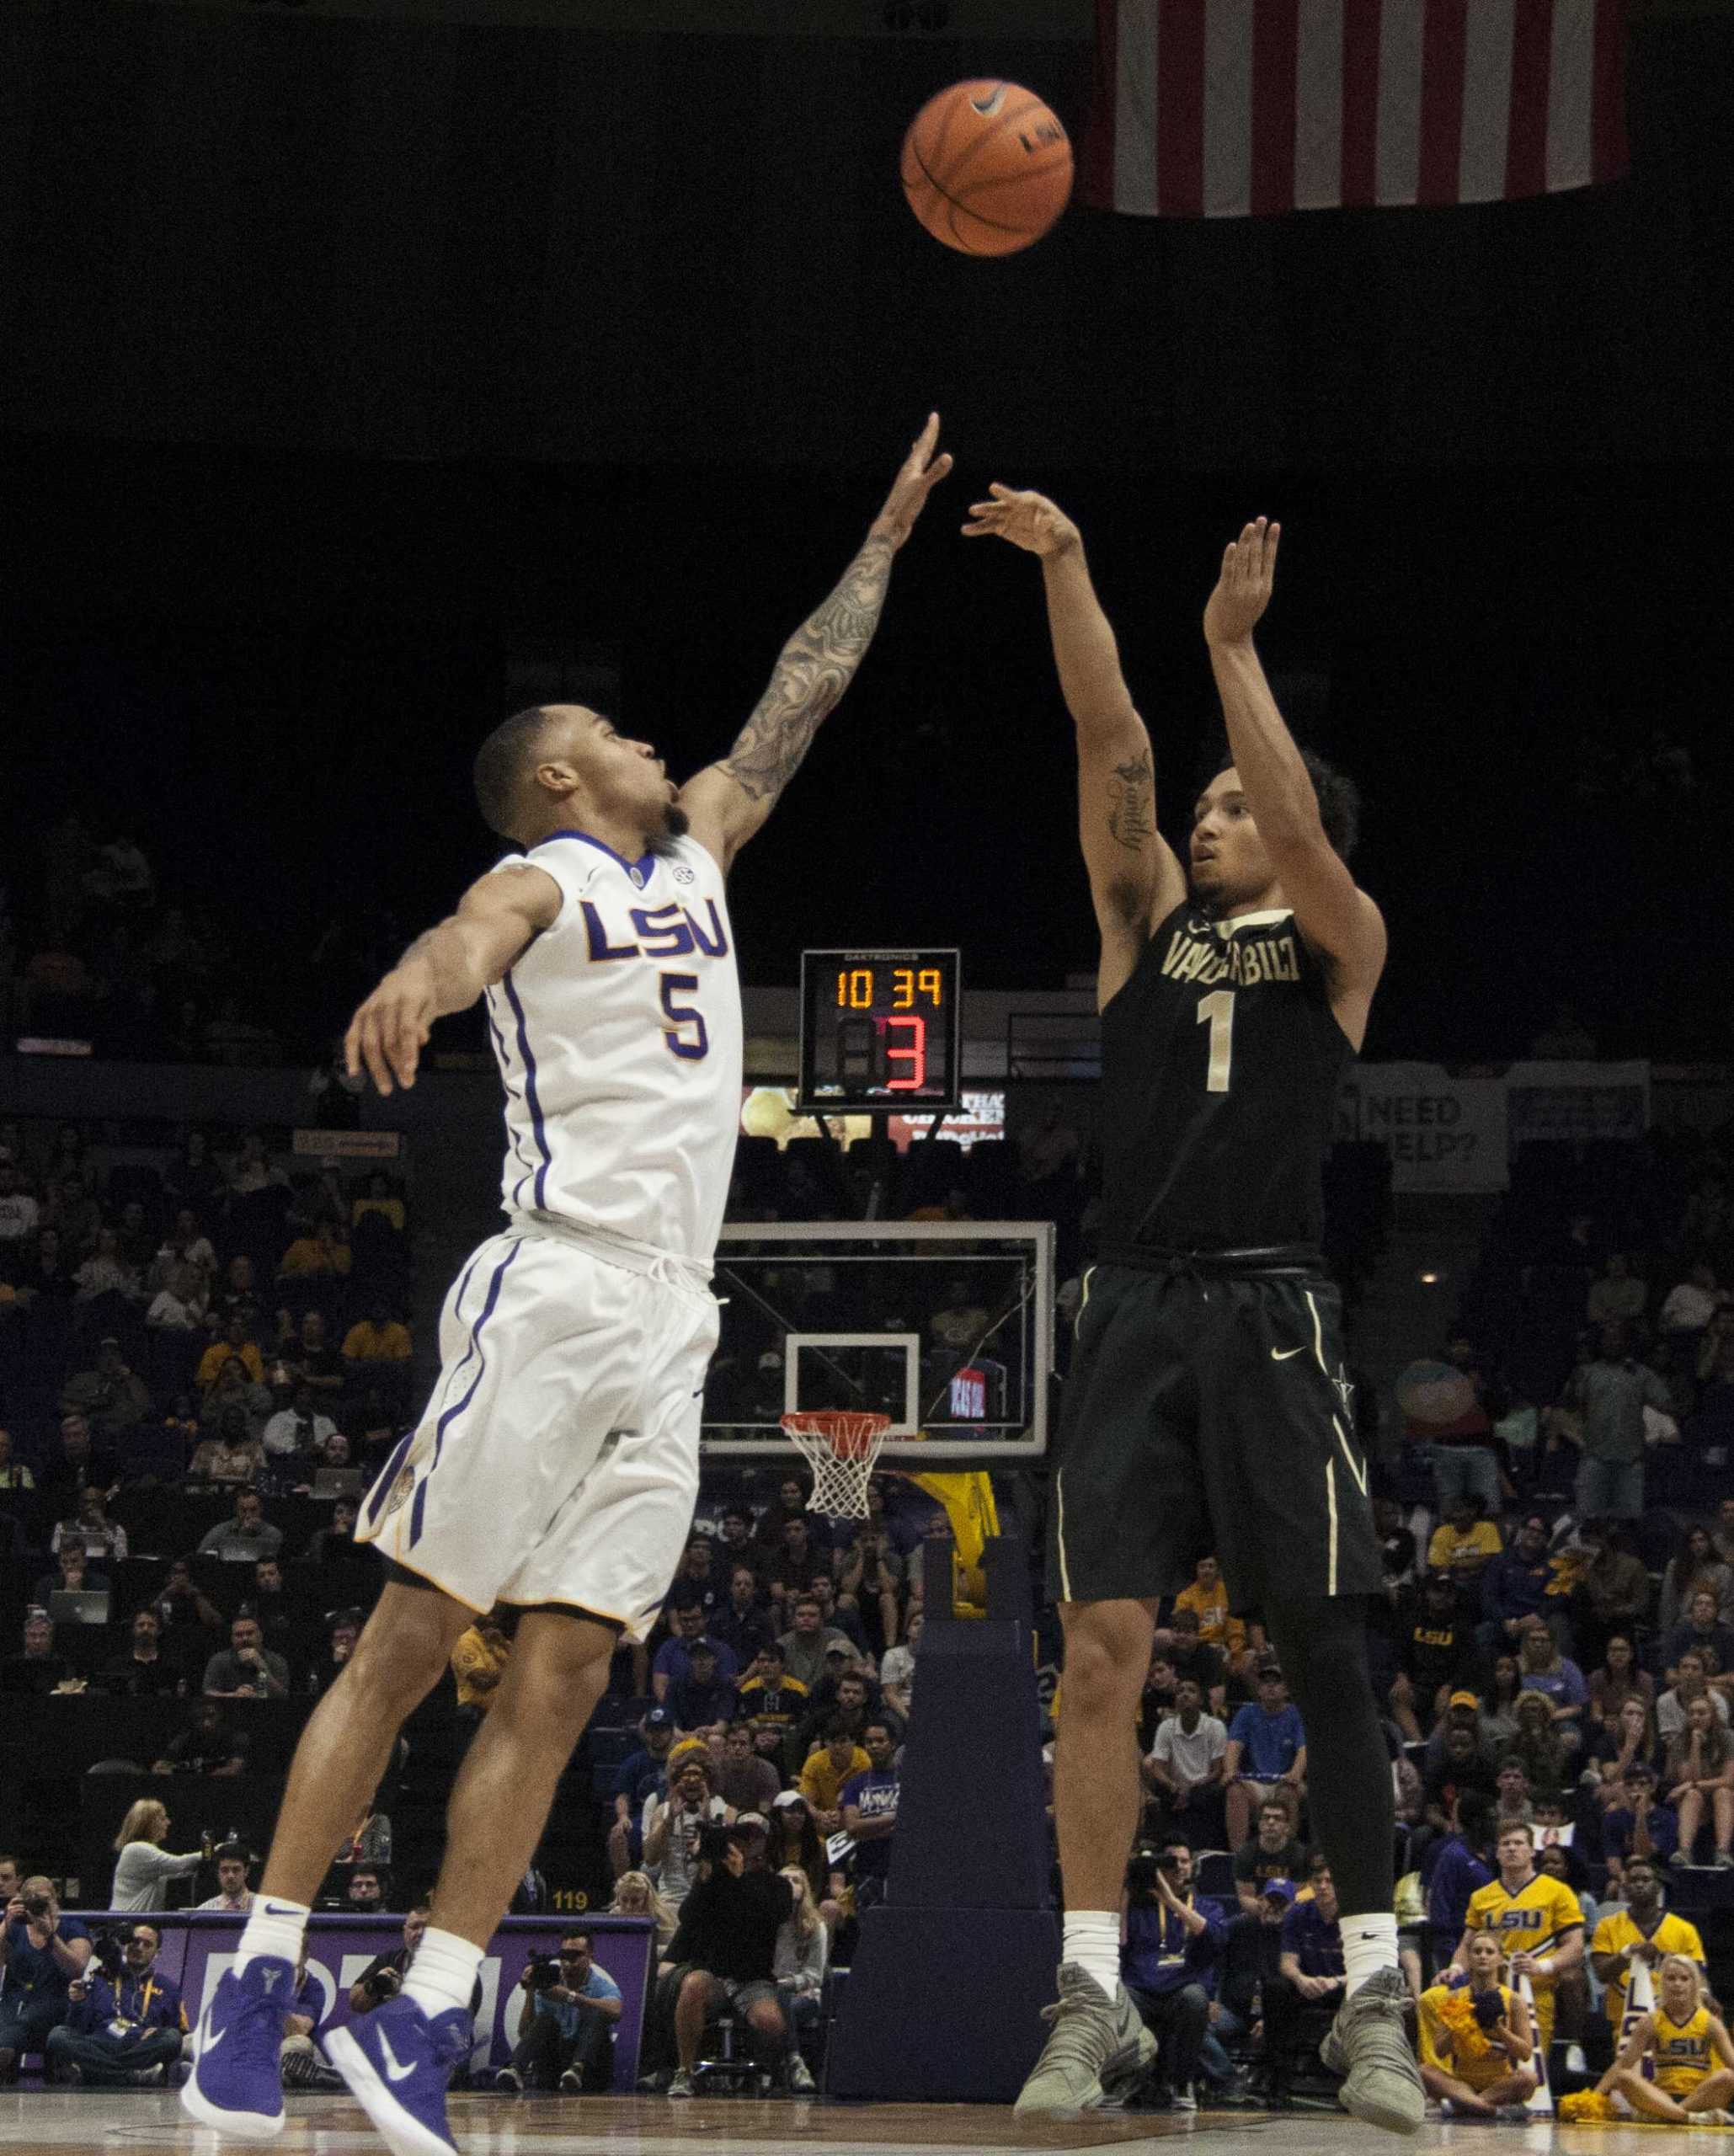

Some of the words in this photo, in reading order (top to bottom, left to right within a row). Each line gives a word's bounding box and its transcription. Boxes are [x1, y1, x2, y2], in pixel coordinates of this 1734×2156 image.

[578, 898, 729, 963] LSU
[837, 969, 874, 1009] 10
[893, 969, 942, 1008] 39
[659, 970, 709, 1062] 5
[886, 1015, 926, 1091] 3
[1196, 990, 1235, 1092] 1
[1367, 1095, 1461, 1126] NEED
[1413, 1626, 1454, 1646] LSU
[552, 1890, 589, 1911] 119
[1485, 1909, 1542, 1931] LSU
